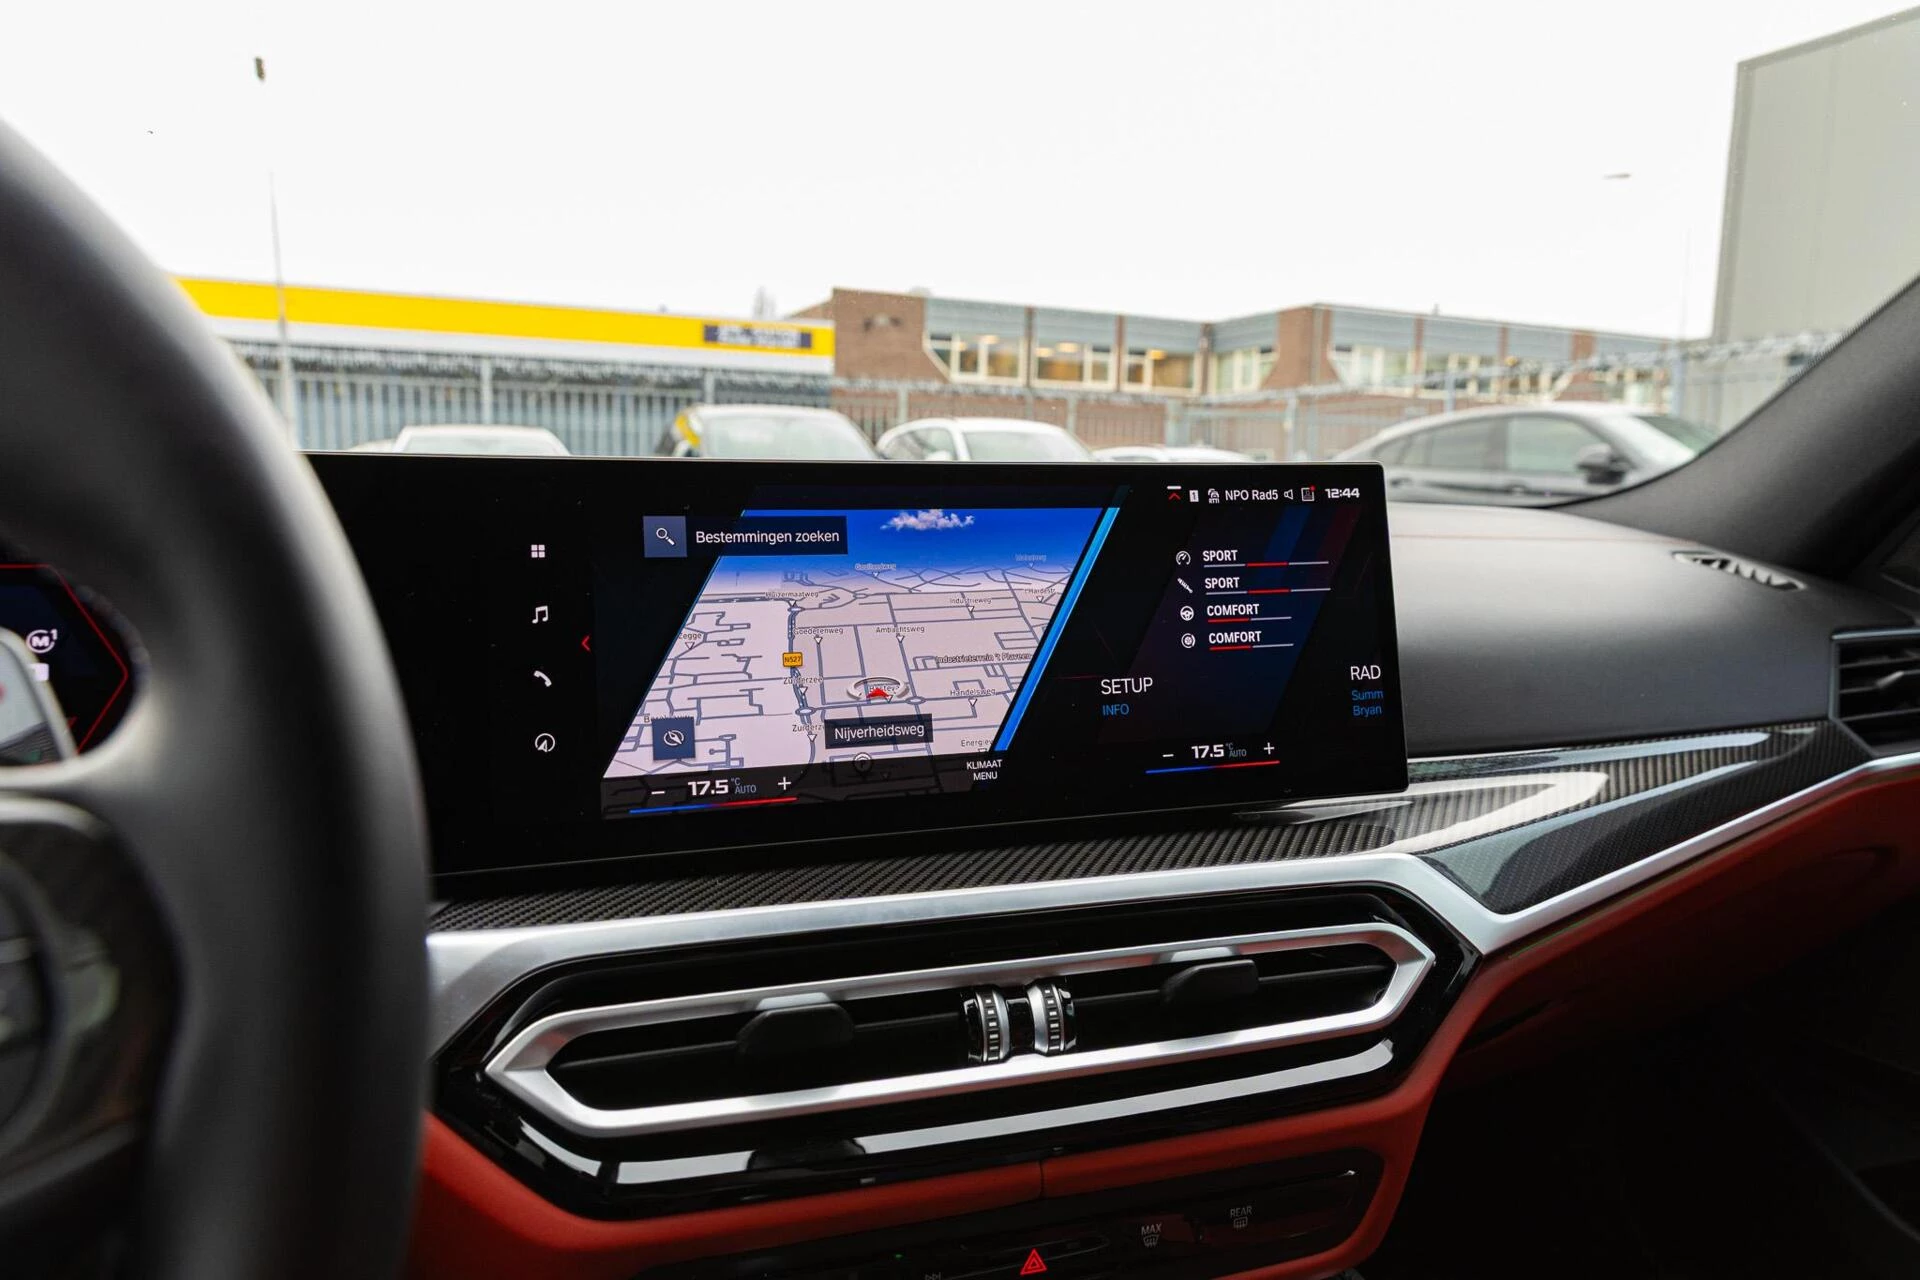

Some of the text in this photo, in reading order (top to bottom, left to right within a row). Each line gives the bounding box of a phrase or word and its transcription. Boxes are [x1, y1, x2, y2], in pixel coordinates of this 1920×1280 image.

[1225, 488, 1279, 502] NPO Rad5
[1325, 487, 1360, 499] 12:44
[696, 530, 840, 546] Bestemmingen zoeken
[1202, 550, 1238, 562] SPORT
[1204, 577, 1240, 589] SPORT
[1207, 603, 1260, 616] COMFORT
[1208, 630, 1262, 643] COMFORT
[784, 655, 802, 664] N527
[1350, 664, 1382, 681] RAD
[1101, 676, 1153, 695] SETUP
[950, 687, 996, 698] Handelsweg
[1351, 688, 1384, 700] Summ
[1102, 704, 1130, 716] INFO
[1352, 704, 1382, 718] Bryan
[834, 724, 925, 742] Nijverheidsweg
[1191, 744, 1224, 759] 17.5
[1229, 748, 1247, 757] AUTO
[966, 759, 1003, 769] KLIMAAT
[973, 771, 998, 780] MENU
[687, 779, 729, 796] 17.5
[734, 784, 757, 794] AUTO
[1230, 1206, 1253, 1218] REAR
[1141, 1223, 1162, 1235] MAX
